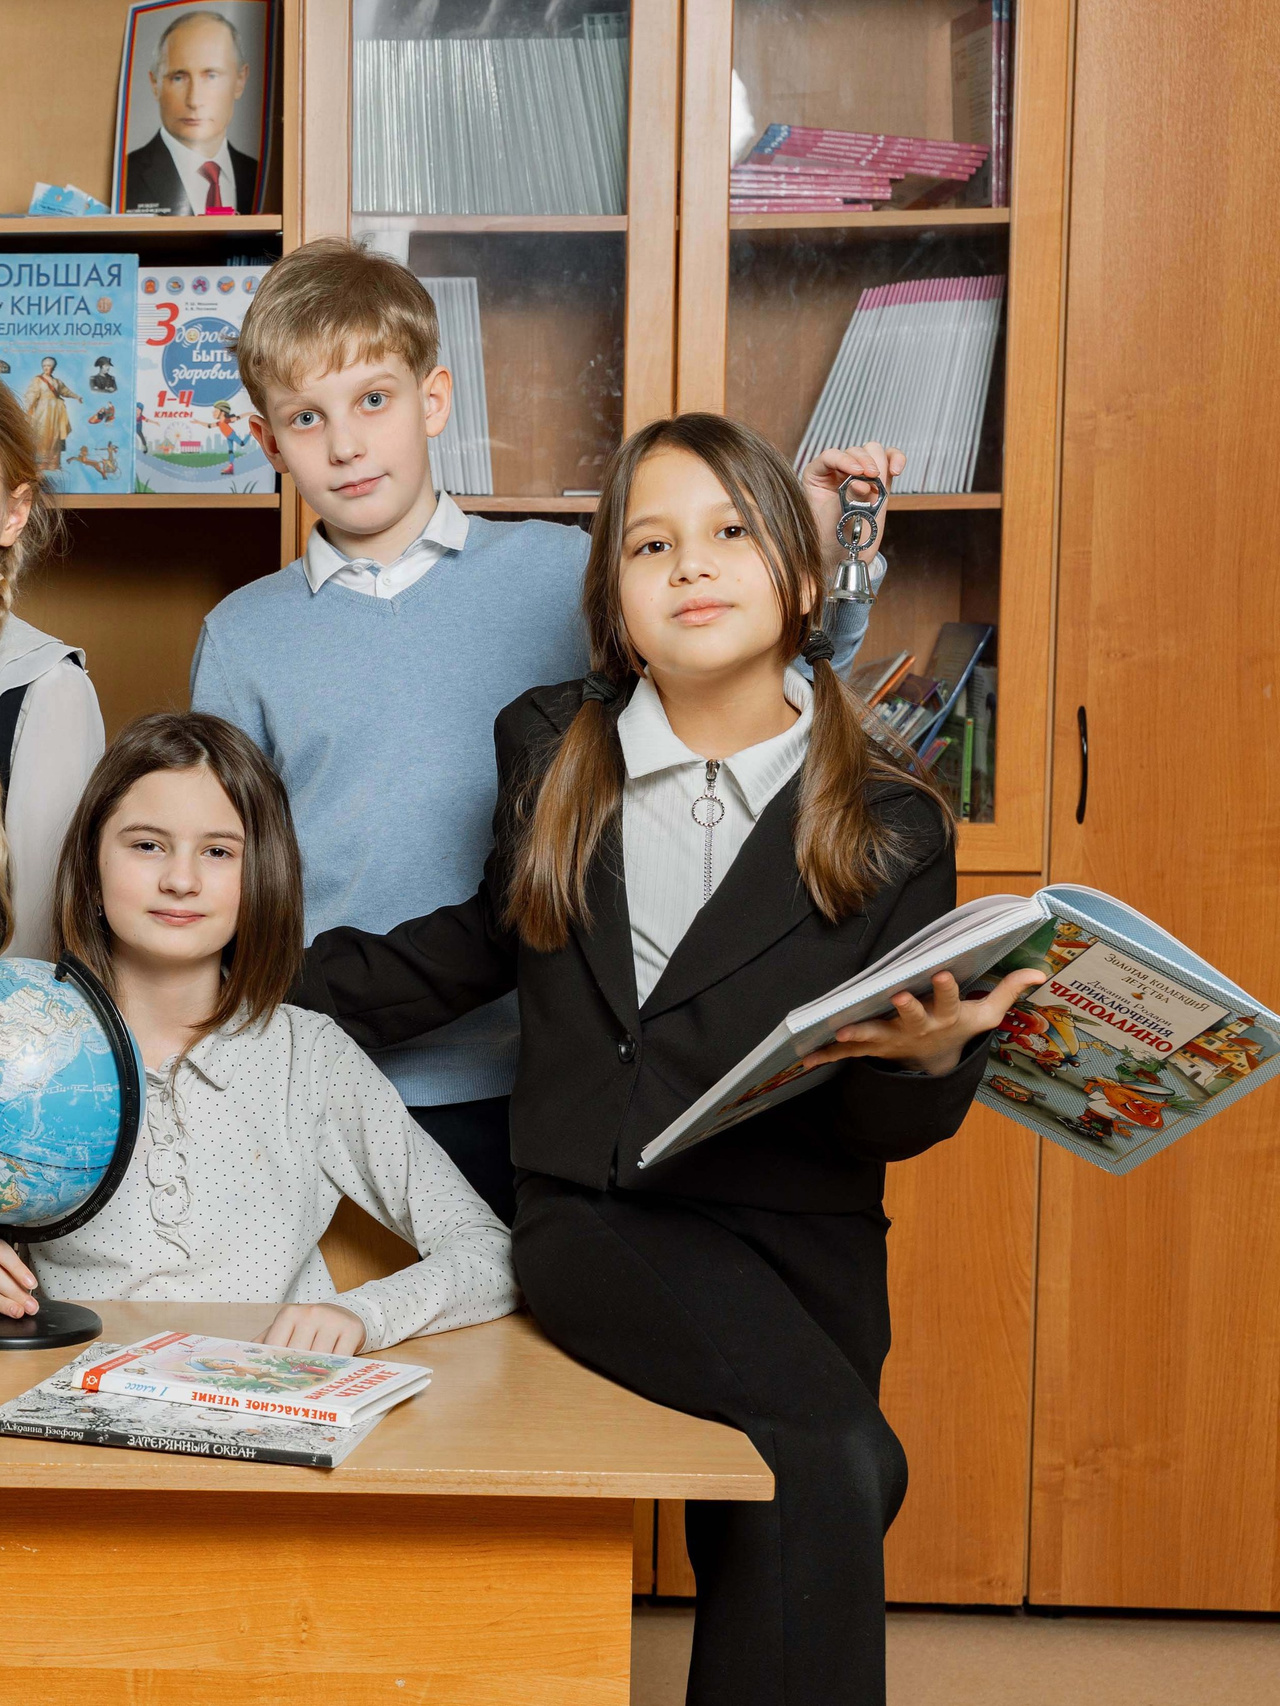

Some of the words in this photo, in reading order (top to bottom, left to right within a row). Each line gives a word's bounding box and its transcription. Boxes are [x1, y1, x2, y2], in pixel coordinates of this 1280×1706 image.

[10, 296, 91, 316] КНИГА
[63, 323, 122, 338] ЛЮДЯХ
[192, 350, 233, 362] БЫТЬ
[1120, 975, 1170, 1004] ДЕТСТВА
[1049, 980, 1174, 1054] ЧИПОЛЛИНО
[1069, 979, 1175, 1039] ПРИКЛЮЧЕНИЯ
[1133, 1001, 1173, 1027] Родари
[124, 1382, 157, 1393] класс
[159, 1386, 169, 1397] 1
[333, 1369, 400, 1398] ЧТЕНИЕ
[191, 1391, 240, 1407] ЧТЕНИЕ
[1, 1422, 43, 1435] Джоанна
[126, 1434, 210, 1454] ЗАТЕРЯННЫЙ
[212, 1443, 257, 1459] ОКЕАН
